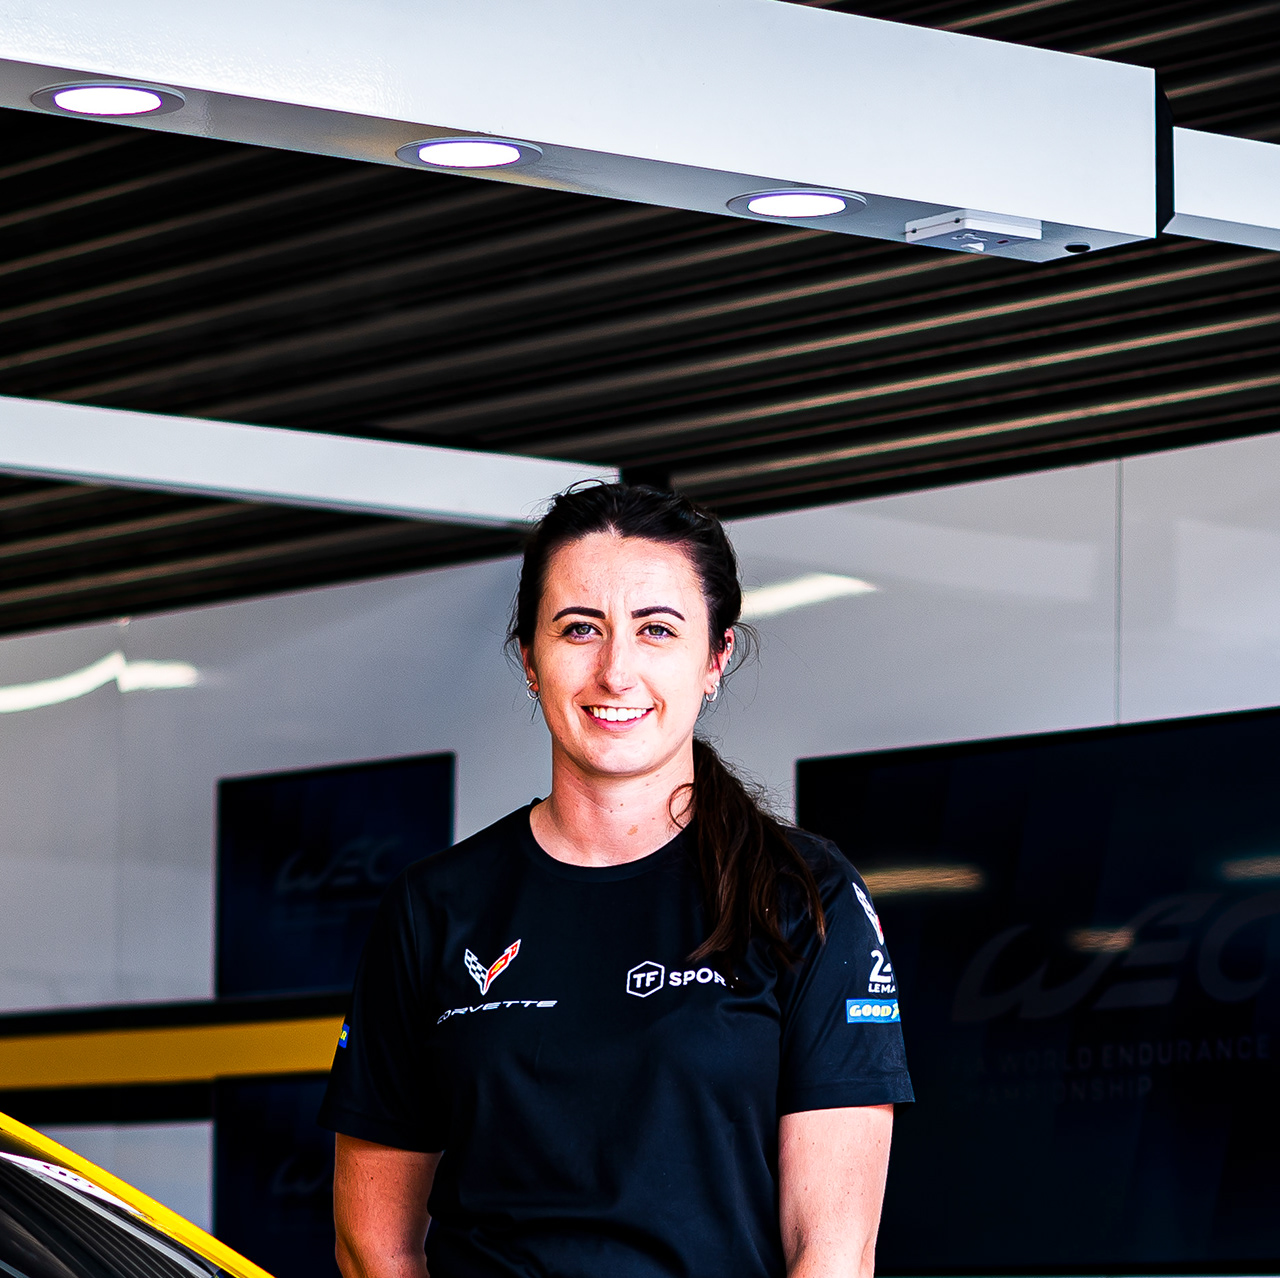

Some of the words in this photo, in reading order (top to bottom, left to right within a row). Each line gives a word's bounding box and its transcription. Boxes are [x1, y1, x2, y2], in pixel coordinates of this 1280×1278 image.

[633, 970, 660, 989] TF
[668, 966, 739, 990] SPOR
[436, 999, 558, 1025] CORVETTE
[1100, 1031, 1272, 1070] ENDURANCE
